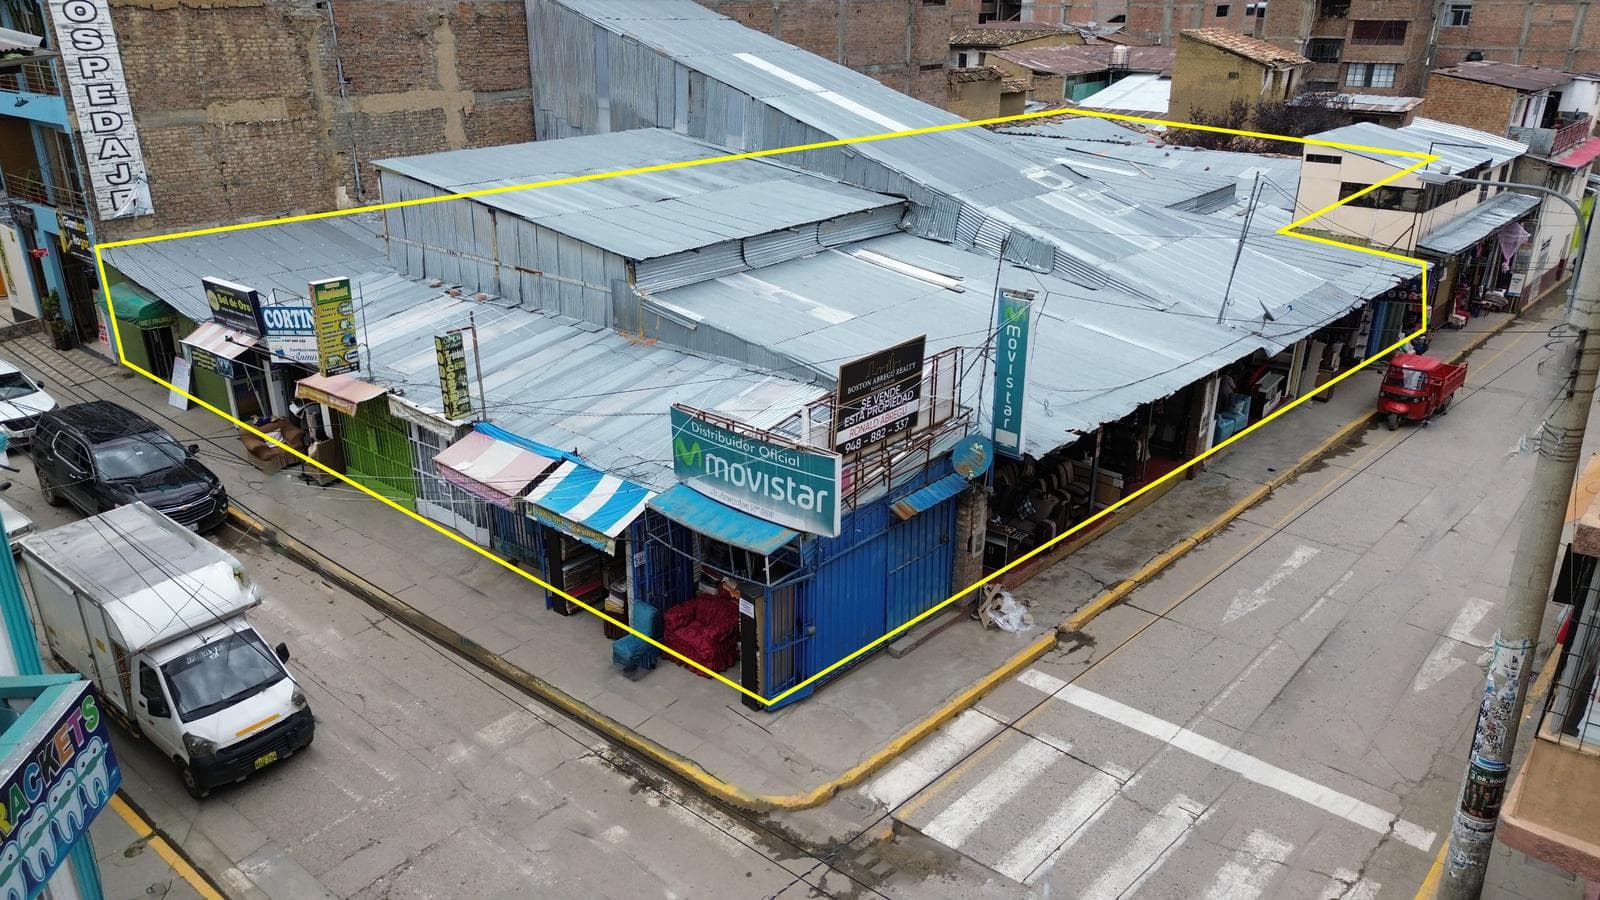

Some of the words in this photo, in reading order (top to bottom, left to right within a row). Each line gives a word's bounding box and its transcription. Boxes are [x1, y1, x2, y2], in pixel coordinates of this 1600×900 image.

[847, 378, 872, 395] BOSTON
[895, 362, 917, 375] REALTY
[1003, 324, 1021, 429] movistar
[844, 409, 866, 427] ESTA
[866, 390, 914, 419] PROPIEDAD
[861, 397, 872, 410] SE
[873, 385, 902, 406] VENDE
[691, 421, 756, 454] Distribuidor
[758, 445, 800, 468] Oficial
[845, 438, 862, 454] 948
[870, 427, 887, 443] 882
[894, 417, 910, 433] 337
[849, 418, 880, 439] RONALD
[705, 453, 829, 513] movistar
[0, 694, 101, 840] RACKETS
